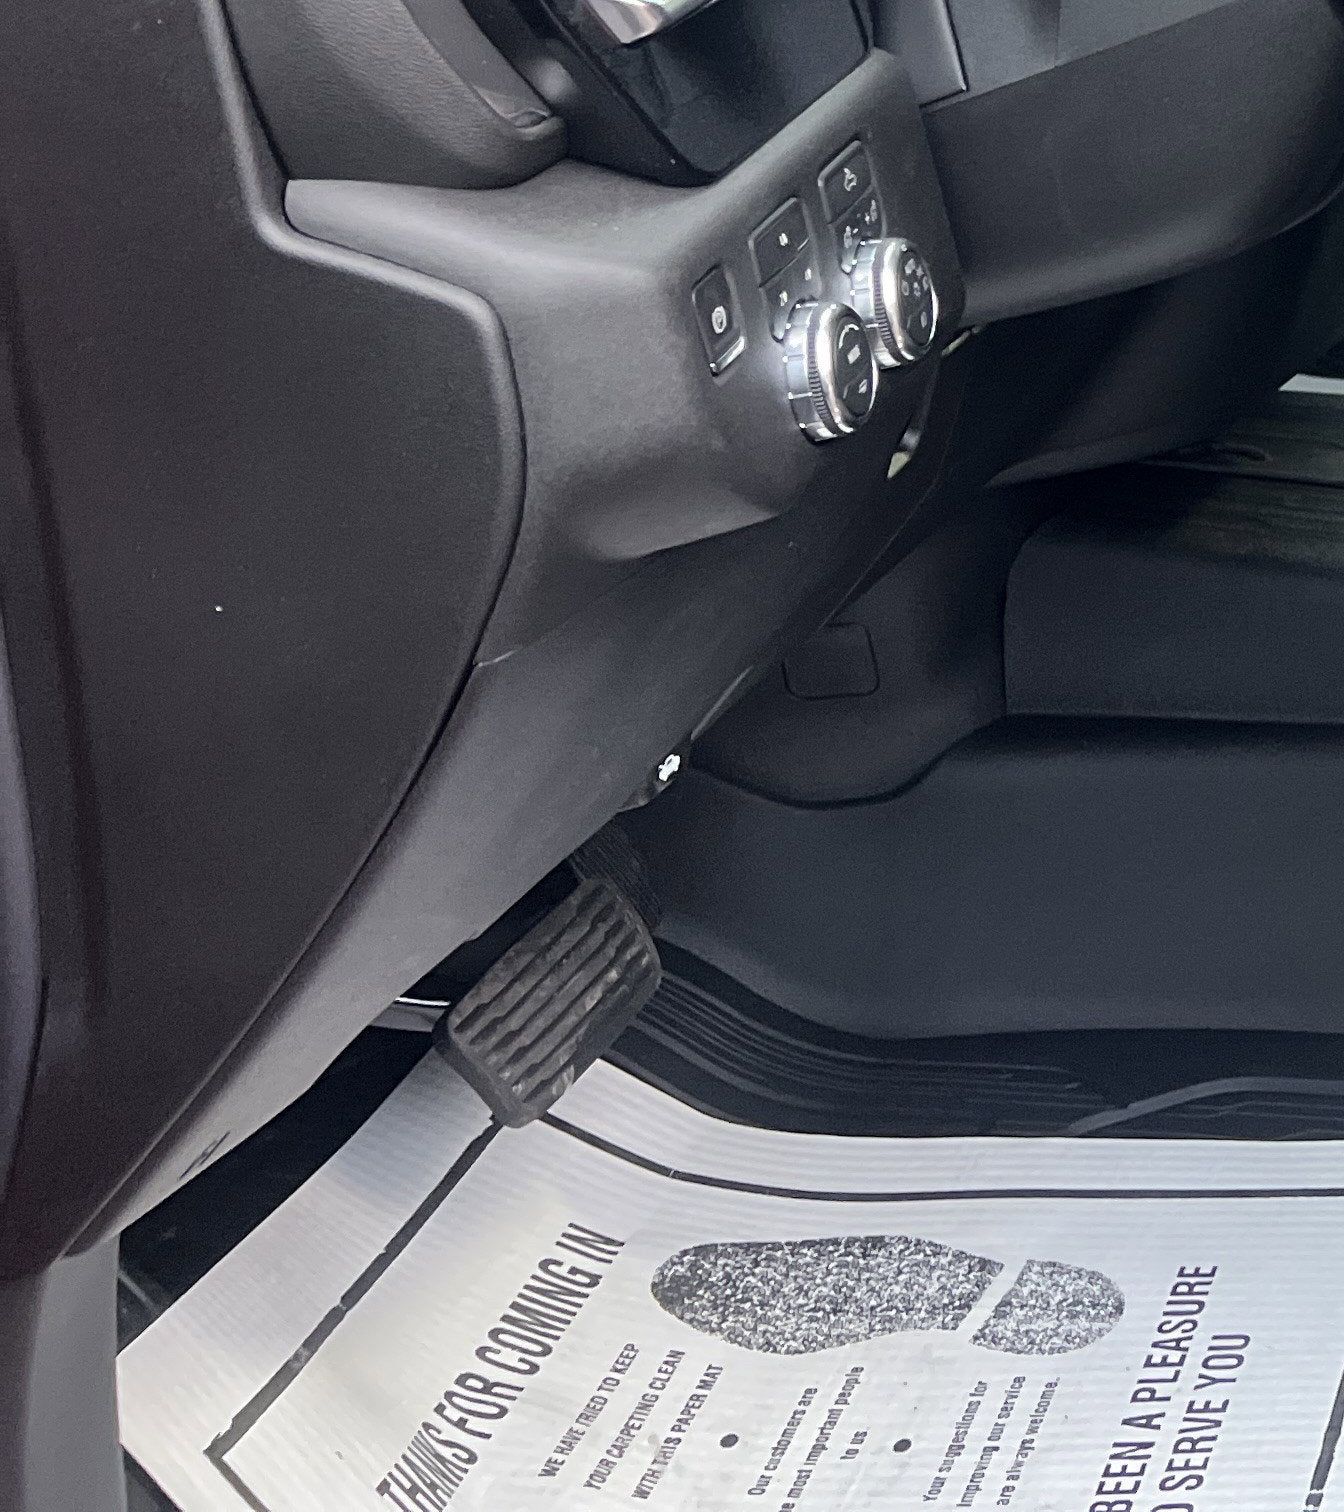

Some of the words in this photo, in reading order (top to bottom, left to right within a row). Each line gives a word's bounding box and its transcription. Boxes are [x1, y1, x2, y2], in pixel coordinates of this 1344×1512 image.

[555, 1221, 626, 1265] IN
[474, 1257, 603, 1376] COMING
[1130, 1265, 1218, 1404] PLEASURE
[1193, 1333, 1252, 1392] YOU
[433, 1371, 525, 1440] FOR
[537, 1456, 566, 1478] WE
[552, 1426, 586, 1456] HAVE
[574, 1394, 608, 1428] TRIED
[596, 1376, 621, 1393] TO
[609, 1342, 640, 1375] KEEP
[582, 1457, 618, 1491] YOUR
[605, 1392, 660, 1459] CARPETING
[648, 1349, 686, 1391] CLEAN
[631, 1467, 662, 1500] WITH
[651, 1436, 683, 1466] THIS
[670, 1392, 709, 1434] PAPER
[695, 1363, 724, 1392] MAT
[747, 1473, 772, 1496] Our
[763, 1408, 807, 1471] customers
[797, 1387, 818, 1407] are
[787, 1468, 813, 1499] most
[803, 1408, 844, 1466] important
[834, 1366, 865, 1406] people
[922, 1476, 947, 1502] Your
[938, 1400, 982, 1473] suggestions
[968, 1380, 988, 1397] for
[987, 1421, 1006, 1442] our
[997, 1375, 1026, 1420] service
[1120, 1412, 1167, 1431] A
[1158, 1398, 1231, 1492] SERVE
[376, 1420, 479, 1512] THANKS
[839, 1447, 860, 1460] to
[996, 1485, 1016, 1506] are
[1005, 1438, 1036, 1482] always
[1089, 1440, 1156, 1512] BEEN
